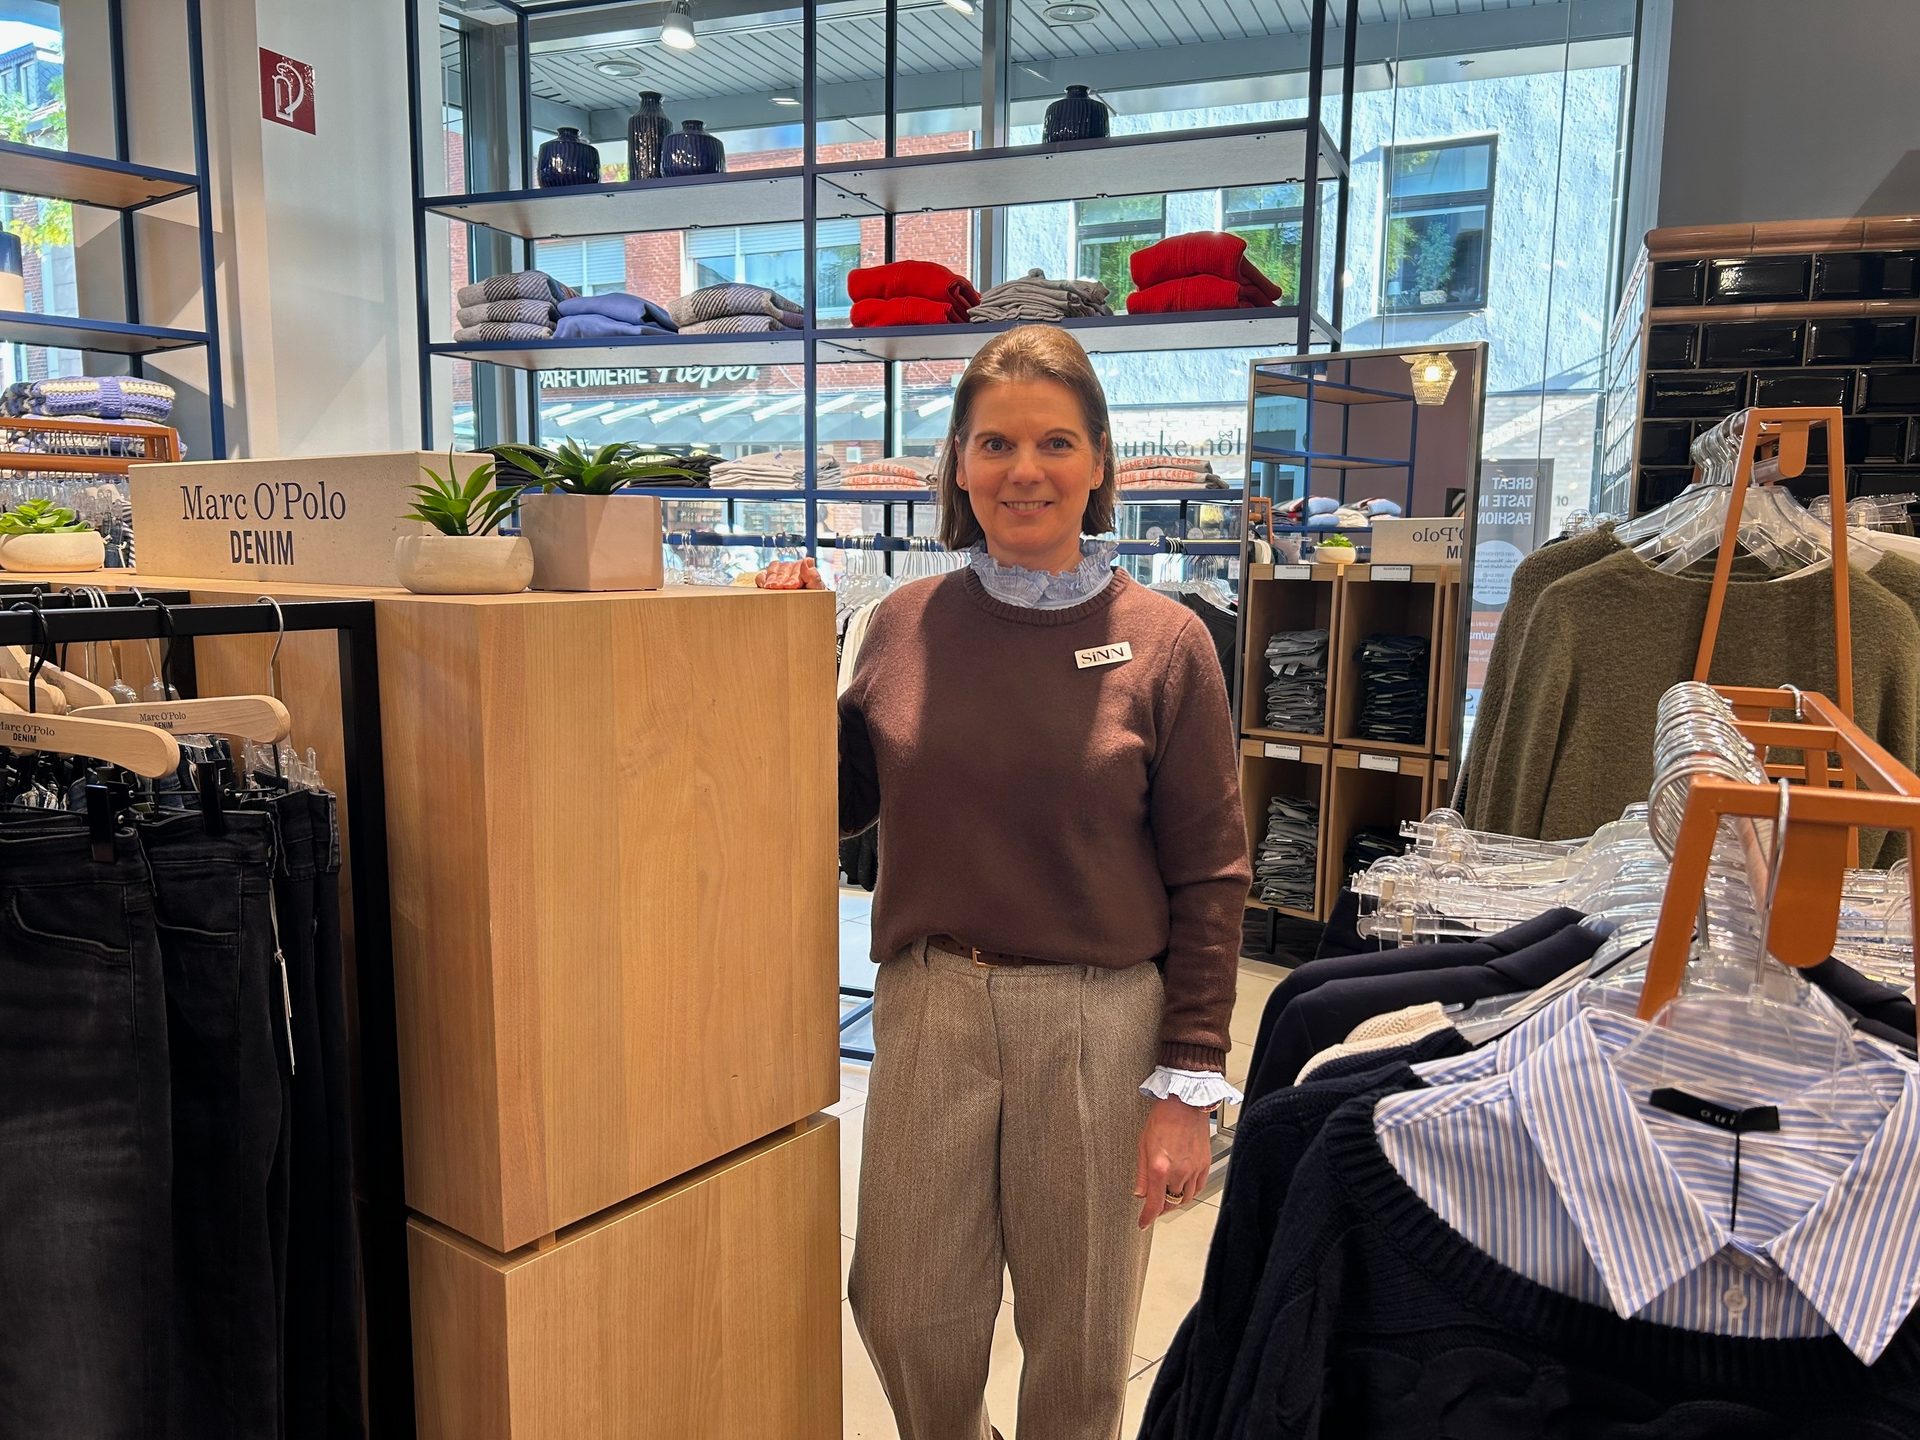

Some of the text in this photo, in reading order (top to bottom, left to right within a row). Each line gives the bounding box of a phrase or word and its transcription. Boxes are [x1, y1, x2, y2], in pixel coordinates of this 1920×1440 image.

[180, 481, 346, 521] Marc O'Polo
[230, 530, 295, 565] DENIM
[140, 711, 187, 722] Marc O'Polo
[23, 724, 56, 737] O'Polo
[13, 732, 37, 743] DENIM
